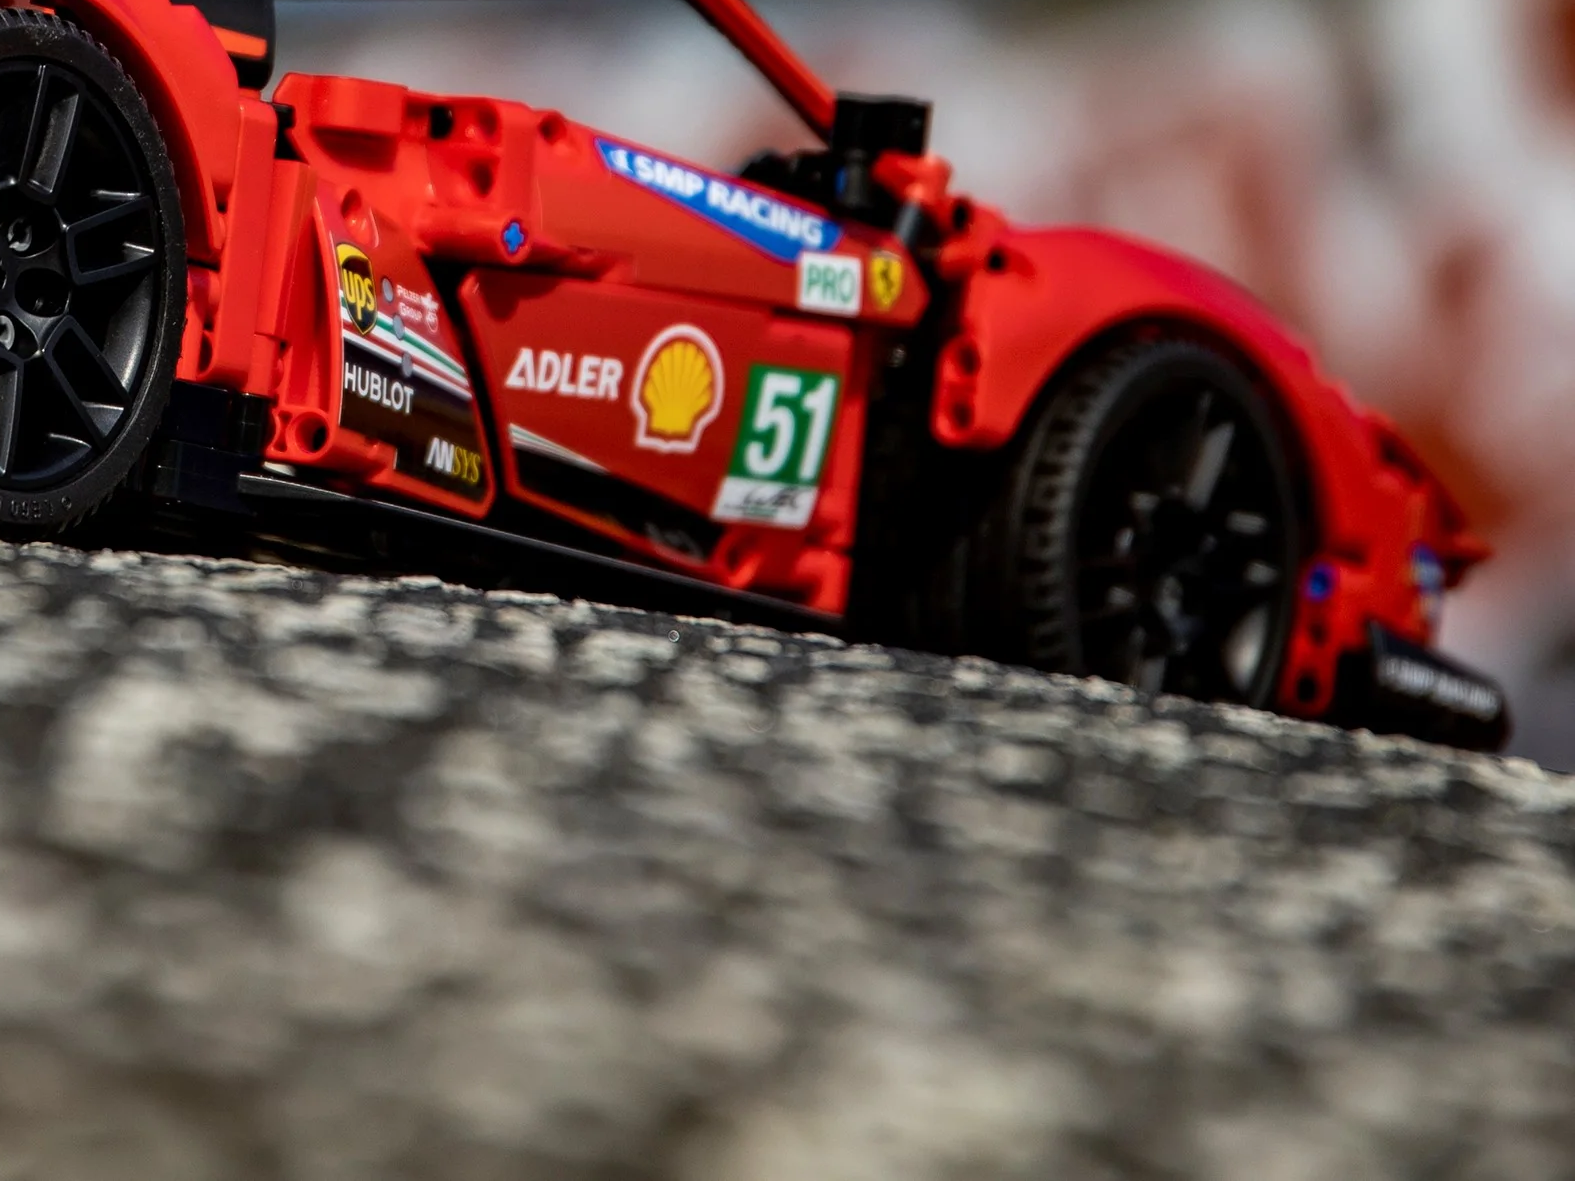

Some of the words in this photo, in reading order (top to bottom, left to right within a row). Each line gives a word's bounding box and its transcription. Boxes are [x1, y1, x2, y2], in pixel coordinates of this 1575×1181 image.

[634, 155, 704, 197] SMP
[706, 179, 824, 248] RACING
[342, 268, 376, 321] ups
[804, 262, 856, 305] PRO
[344, 361, 414, 414] HUBLOT
[505, 348, 623, 402] ADLER
[744, 371, 838, 482] 51
[426, 436, 482, 484] ANSYS
